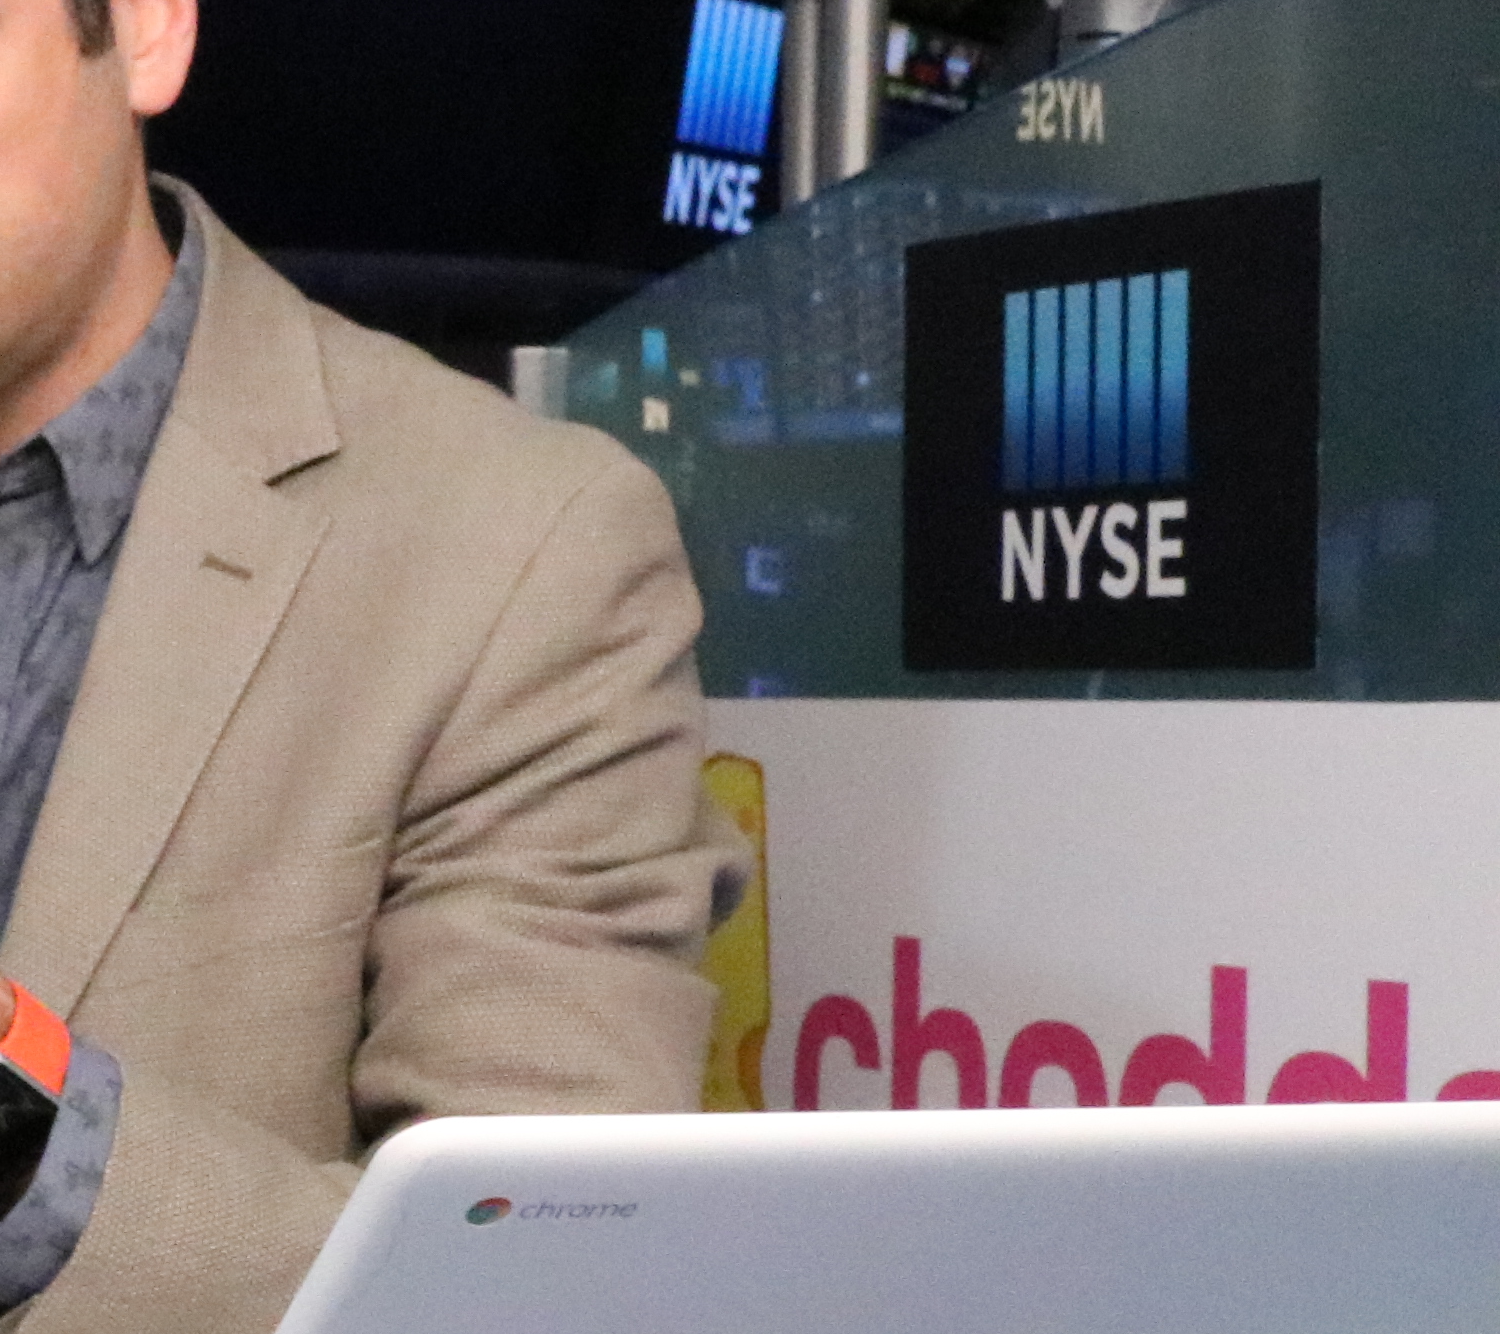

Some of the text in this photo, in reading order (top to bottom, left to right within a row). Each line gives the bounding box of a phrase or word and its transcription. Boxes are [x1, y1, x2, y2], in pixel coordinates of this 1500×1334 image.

[662, 151, 762, 236] NYSE
[1000, 498, 1189, 604] NYSE
[519, 1197, 638, 1222] chrome
